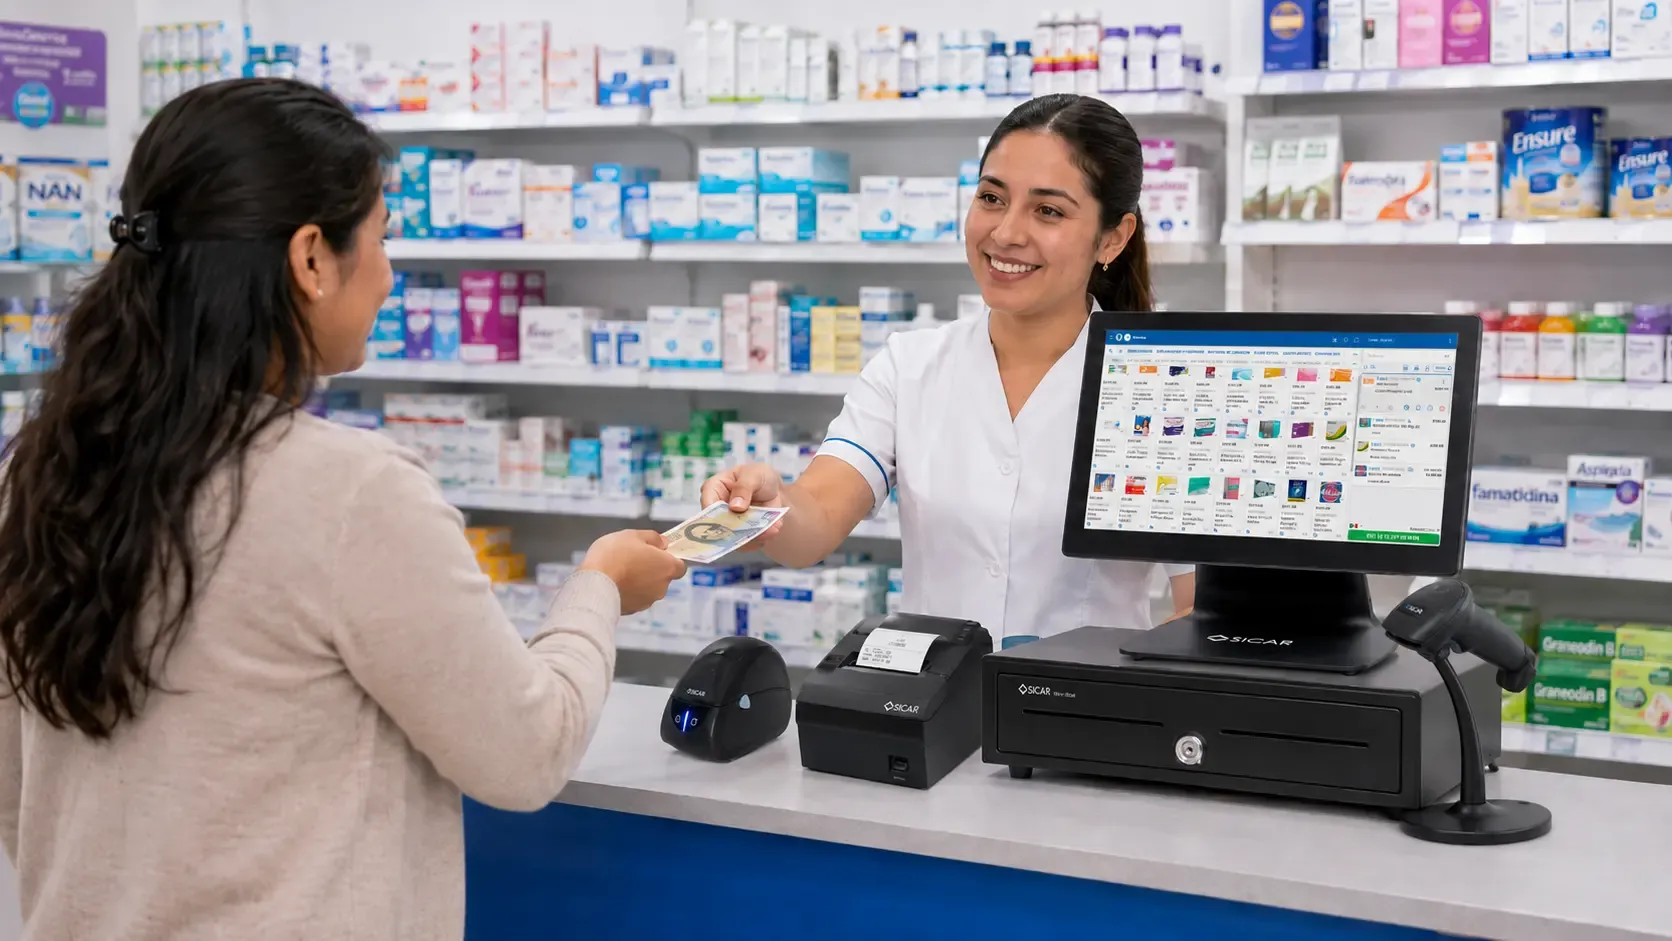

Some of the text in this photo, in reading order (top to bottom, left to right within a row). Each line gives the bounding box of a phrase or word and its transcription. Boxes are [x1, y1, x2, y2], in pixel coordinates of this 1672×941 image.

[1512, 124, 1577, 155] Ensure
[1618, 149, 1669, 173] Ensure
[28, 182, 81, 200] NAN
[1229, 636, 1293, 646] SICAR
[1542, 635, 1615, 657] Graneodin B
[1027, 685, 1051, 696] SICAR
[1534, 682, 1607, 704] Graneodin B
[893, 703, 920, 714] SICAR
